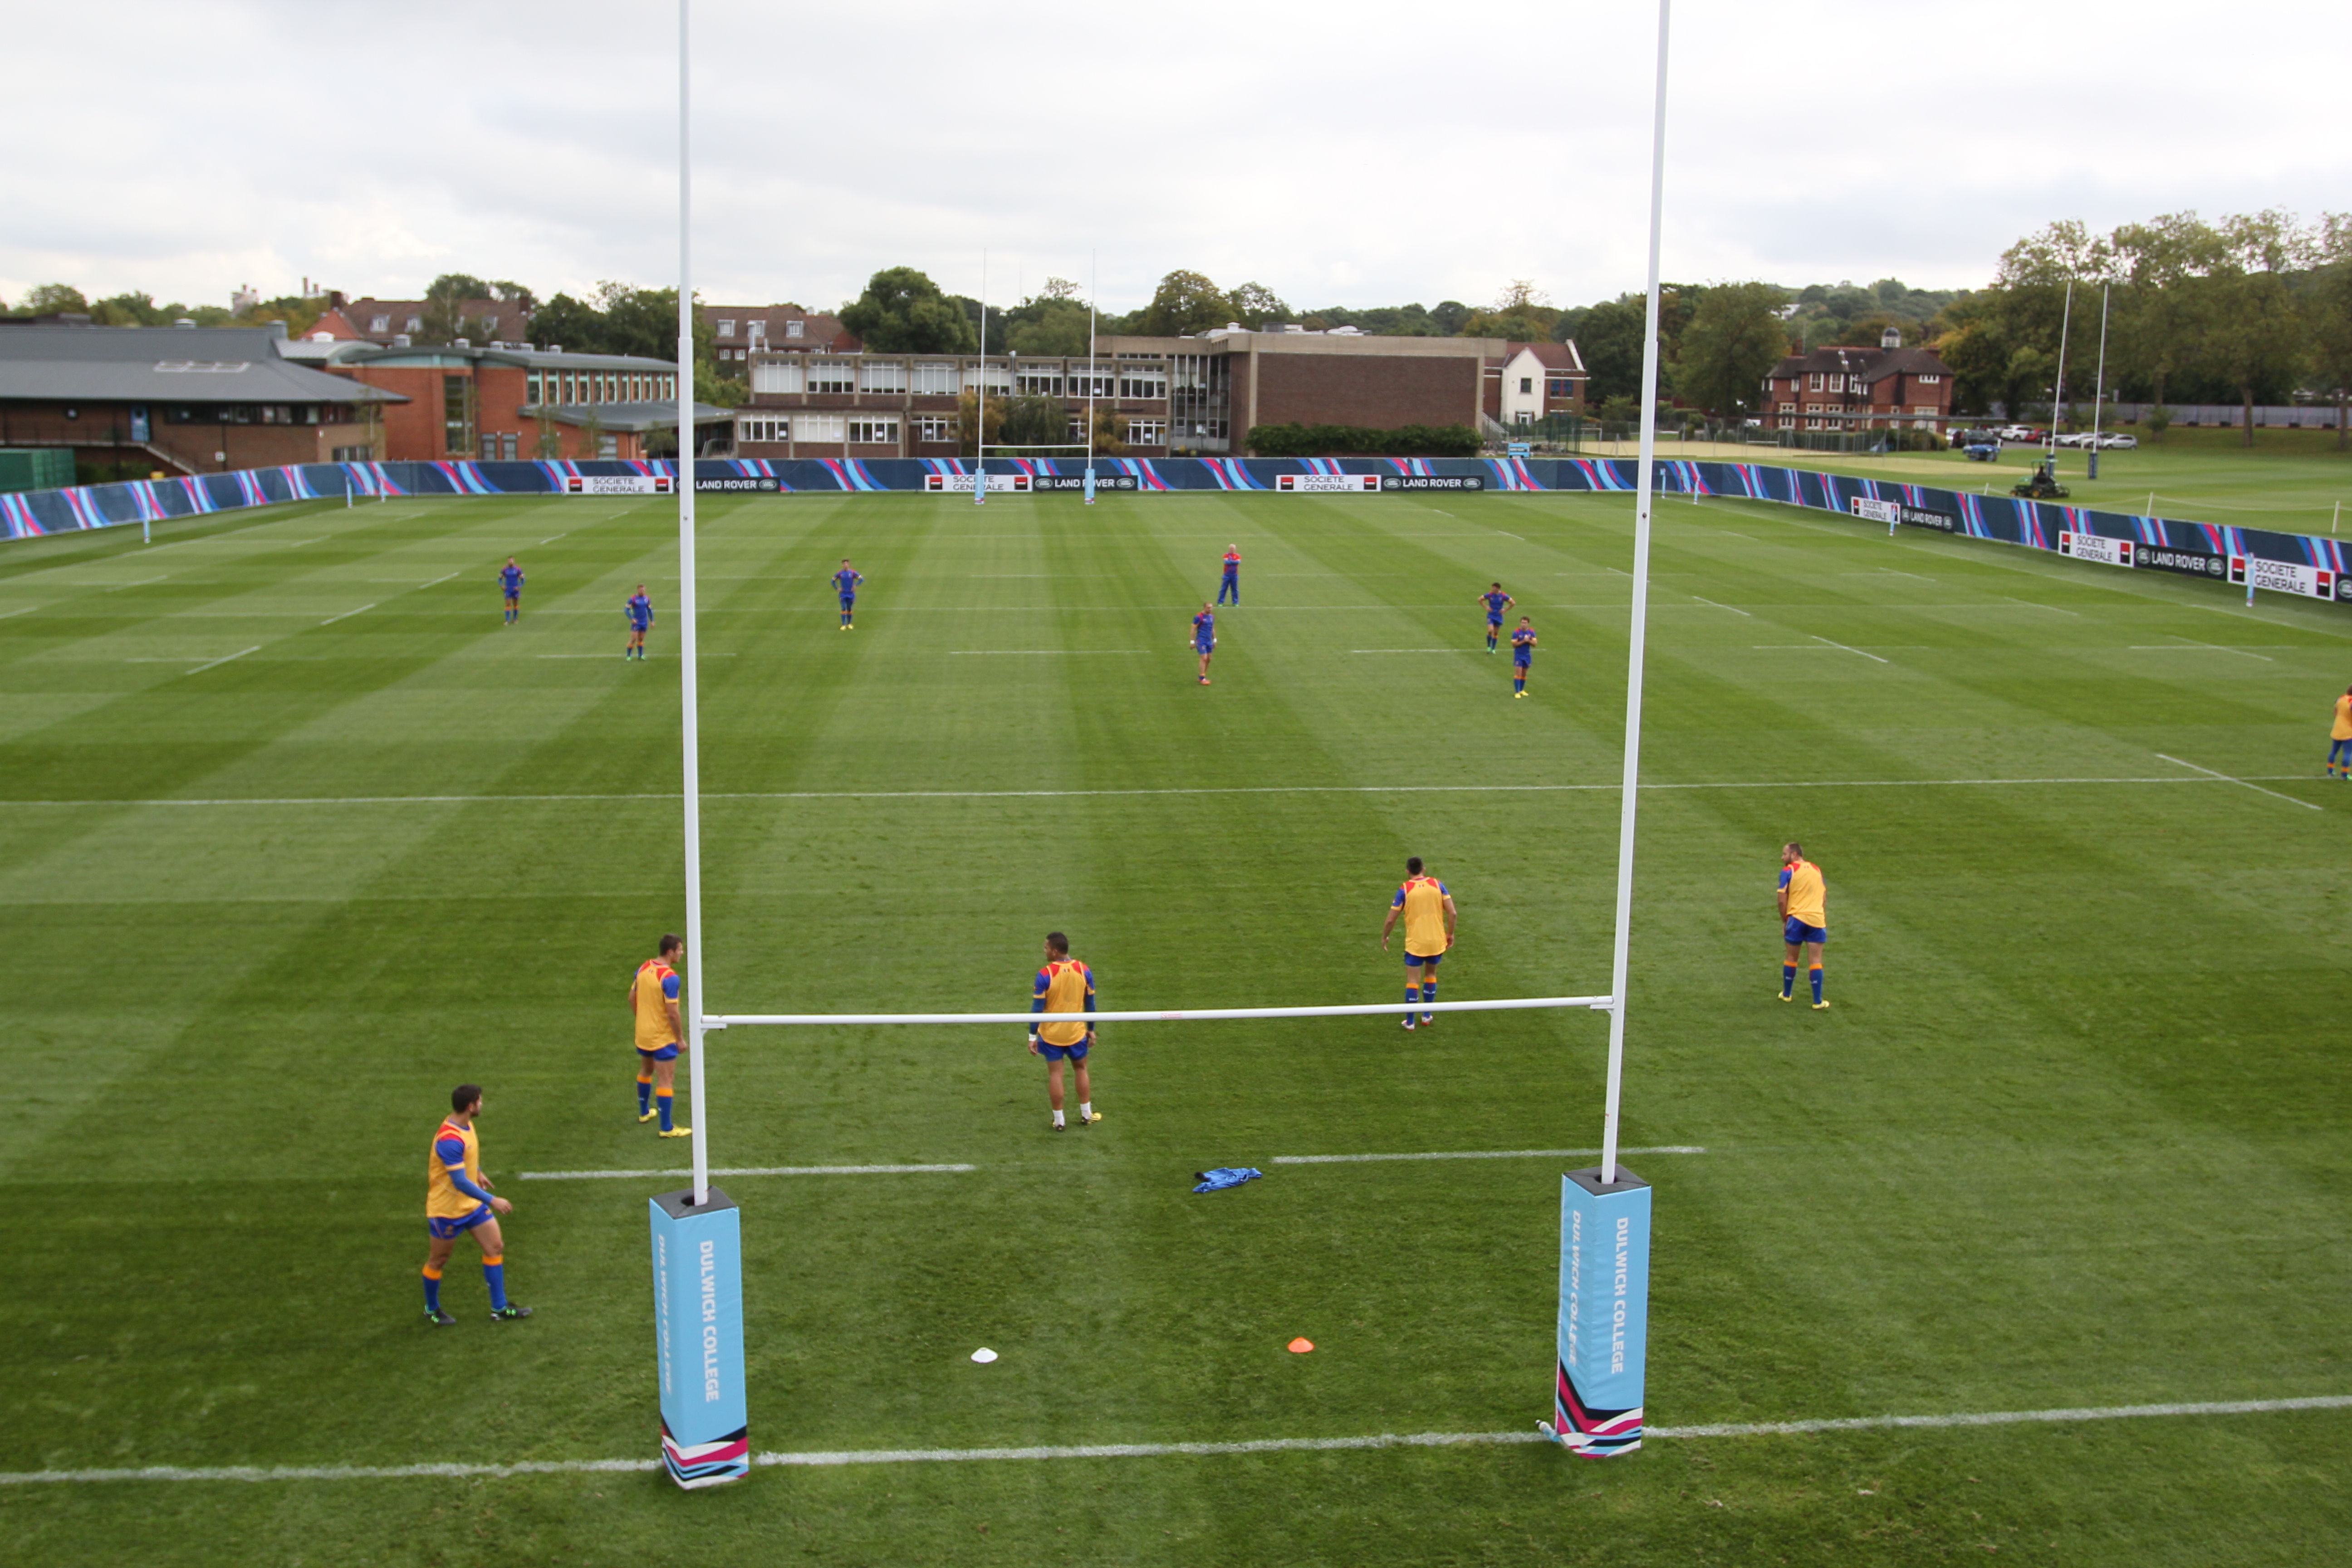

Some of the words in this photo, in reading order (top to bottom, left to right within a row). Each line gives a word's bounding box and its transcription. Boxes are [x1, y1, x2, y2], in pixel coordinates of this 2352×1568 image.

[696, 480, 722, 490] LAND
[724, 480, 757, 490] ROVER
[1054, 479, 1080, 487] LAND
[1402, 479, 1428, 488] LAND
[1429, 479, 1461, 488] ROVER
[1925, 513, 1943, 526] ROVER
[2078, 535, 2106, 549] SOCIETE
[2077, 547, 2112, 562] GENERALE
[2151, 551, 2174, 566] LAND
[2175, 554, 2205, 572] ROVER
[2255, 561, 2297, 578] SOCIETE
[2255, 574, 2306, 593] GENERALE
[1615, 1217, 1629, 1296] DULWICH
[700, 1240, 716, 1323] DULWICH
[1612, 1299, 1626, 1374] COLLEGE
[703, 1325, 720, 1403] COLLEGE
